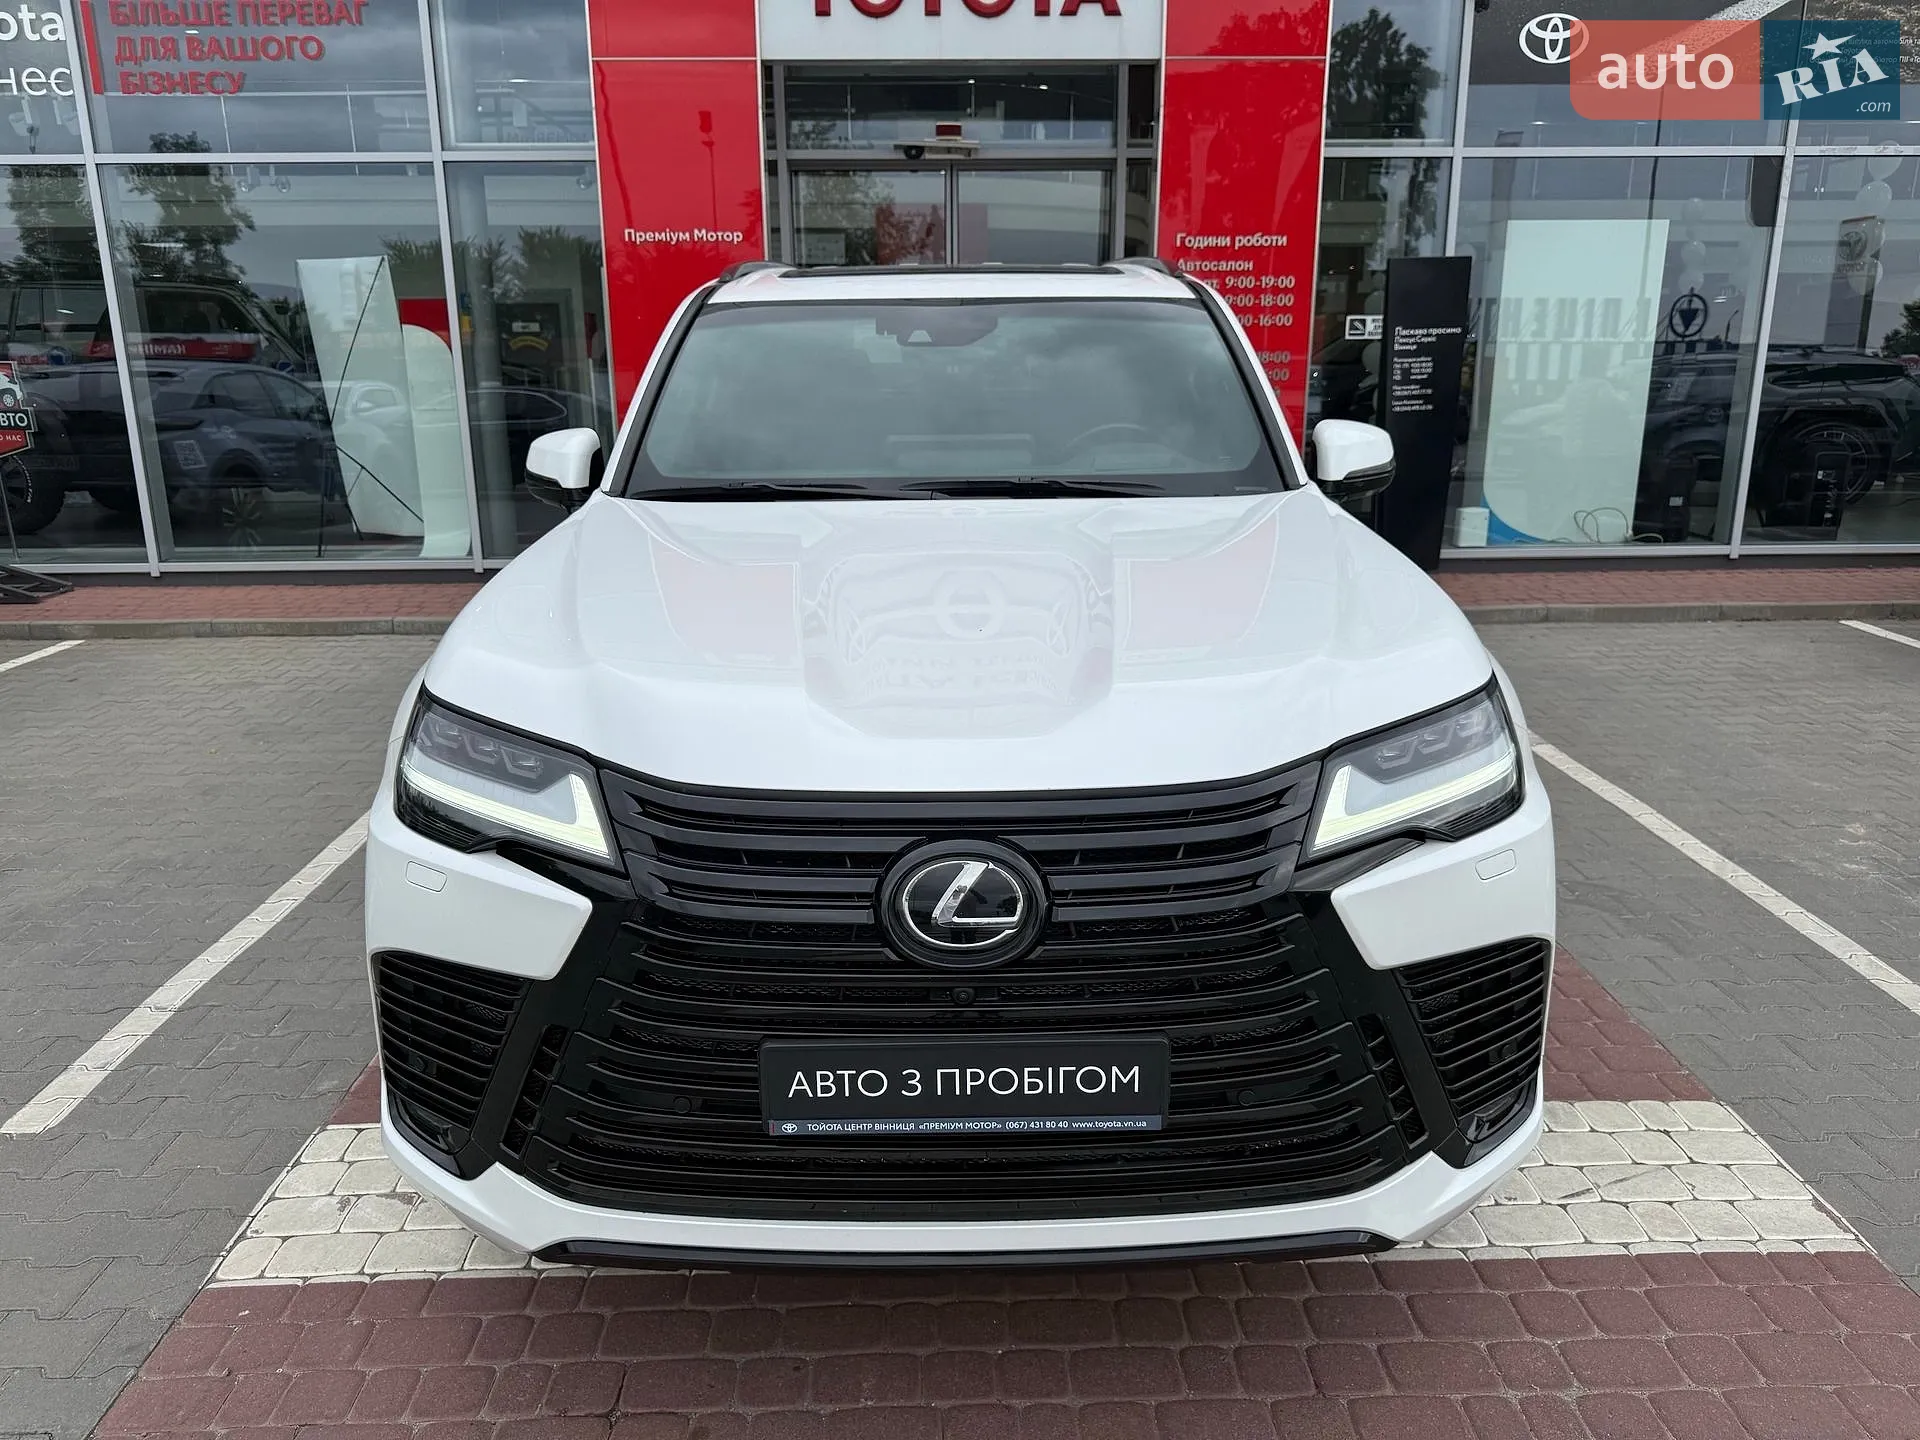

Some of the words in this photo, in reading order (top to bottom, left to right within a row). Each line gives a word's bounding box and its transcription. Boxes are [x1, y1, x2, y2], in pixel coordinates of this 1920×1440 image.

[108, 0, 231, 26] БІЛЬШЕ
[238, 0, 368, 25] ПЕРЕВАГ
[115, 36, 182, 65] ДЛЯ
[185, 36, 325, 61] ВАШОГО
[119, 71, 246, 95] БІЗНЕСУ
[624, 228, 690, 245] Преміум
[694, 228, 743, 245] Мотор
[1176, 232, 1231, 249] Години
[1234, 232, 1288, 250] роботи
[1177, 258, 1253, 271] Автосалон
[1225, 276, 1295, 289] 9:00-19:00
[787, 1069, 888, 1098] АВТО
[901, 1068, 922, 1097] З
[936, 1065, 1140, 1096] ПРОБІГОМ
[807, 1122, 843, 1131] ТОЙОТА
[844, 1122, 873, 1132] ЦЕНТР
[874, 1122, 915, 1132] ВІННИЦЯ
[918, 1121, 963, 1131] «ПРЕМІУМ
[965, 1121, 1002, 1130] МОТОР»
[1005, 1120, 1028, 1130] (067)
[1029, 1121, 1044, 1129] 431
[1045, 1120, 1056, 1129] 80
[1057, 1120, 1069, 1129] 40
[1071, 1119, 1147, 1130] www.toyota.vn.ua
